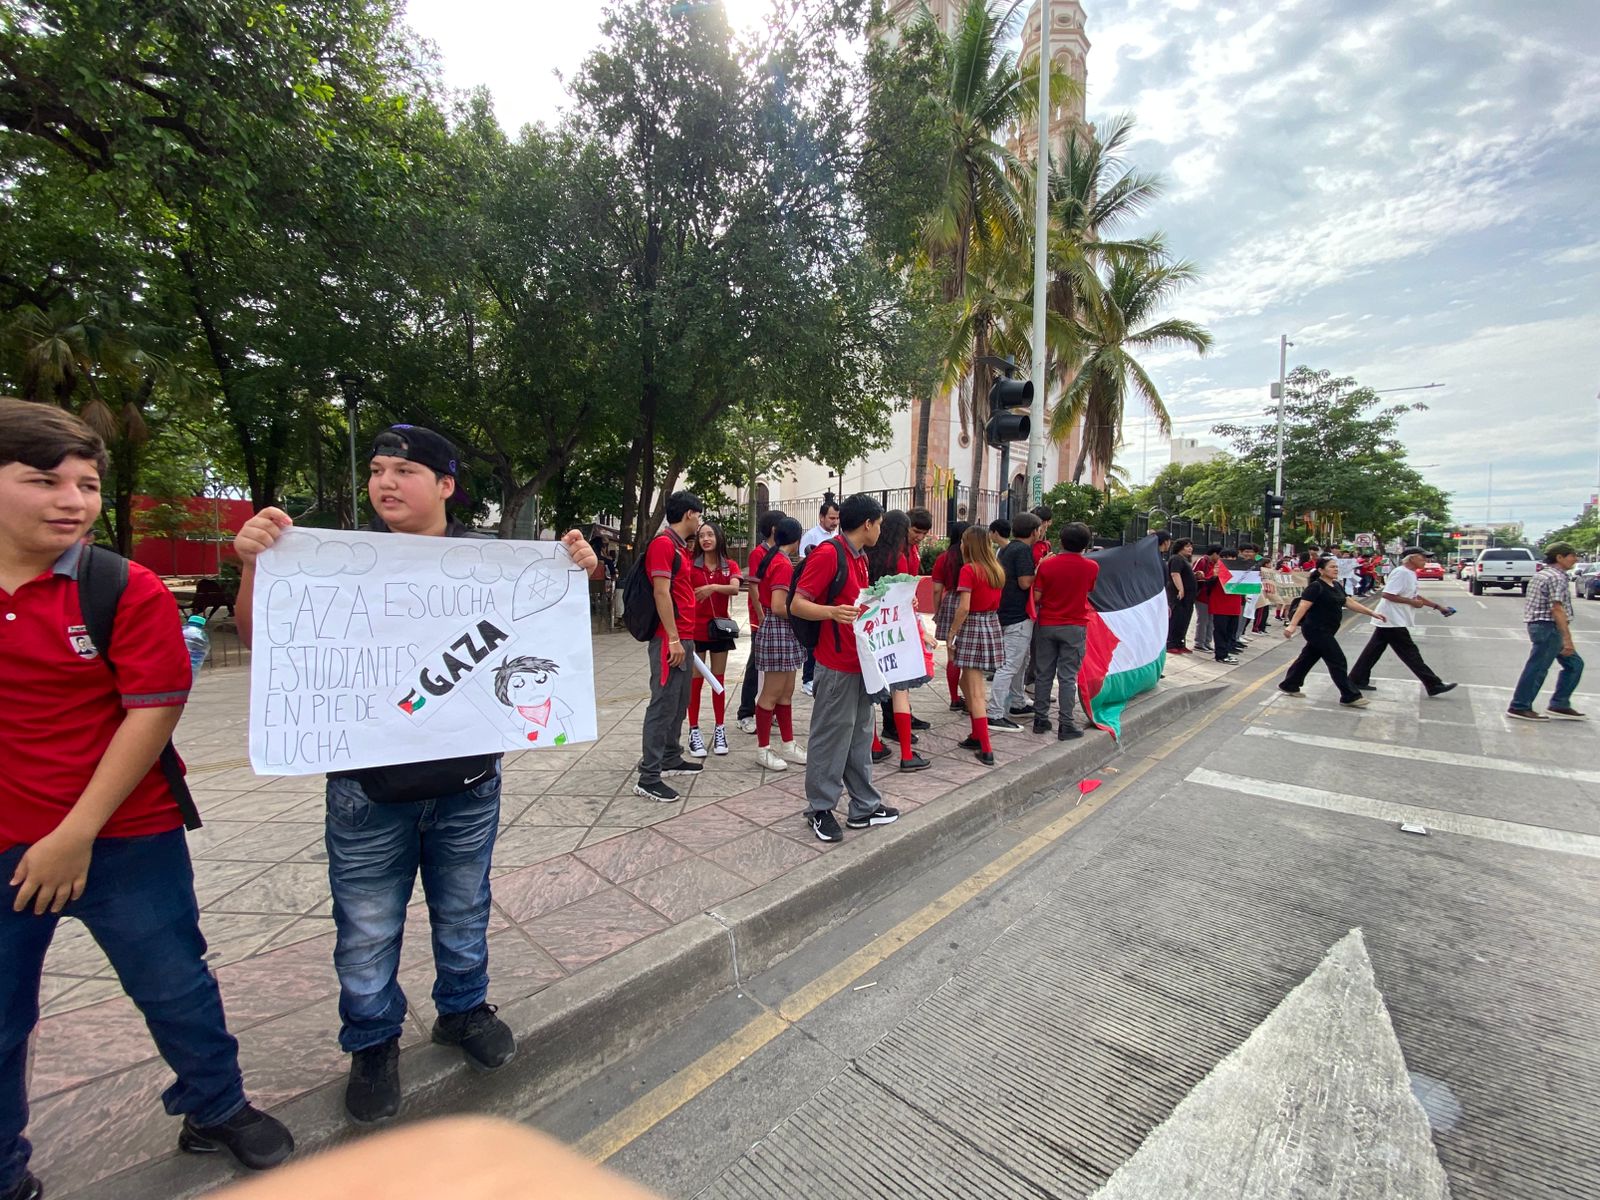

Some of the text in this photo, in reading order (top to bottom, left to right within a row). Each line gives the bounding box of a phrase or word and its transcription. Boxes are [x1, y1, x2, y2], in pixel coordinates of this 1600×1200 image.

[266, 579, 496, 645] GAZA ESCUCHA
[268, 643, 422, 693] ESTUDIANTES
[419, 619, 509, 696] GAZA
[265, 693, 379, 727] EN PIE DE
[264, 729, 352, 767] LUCHA
